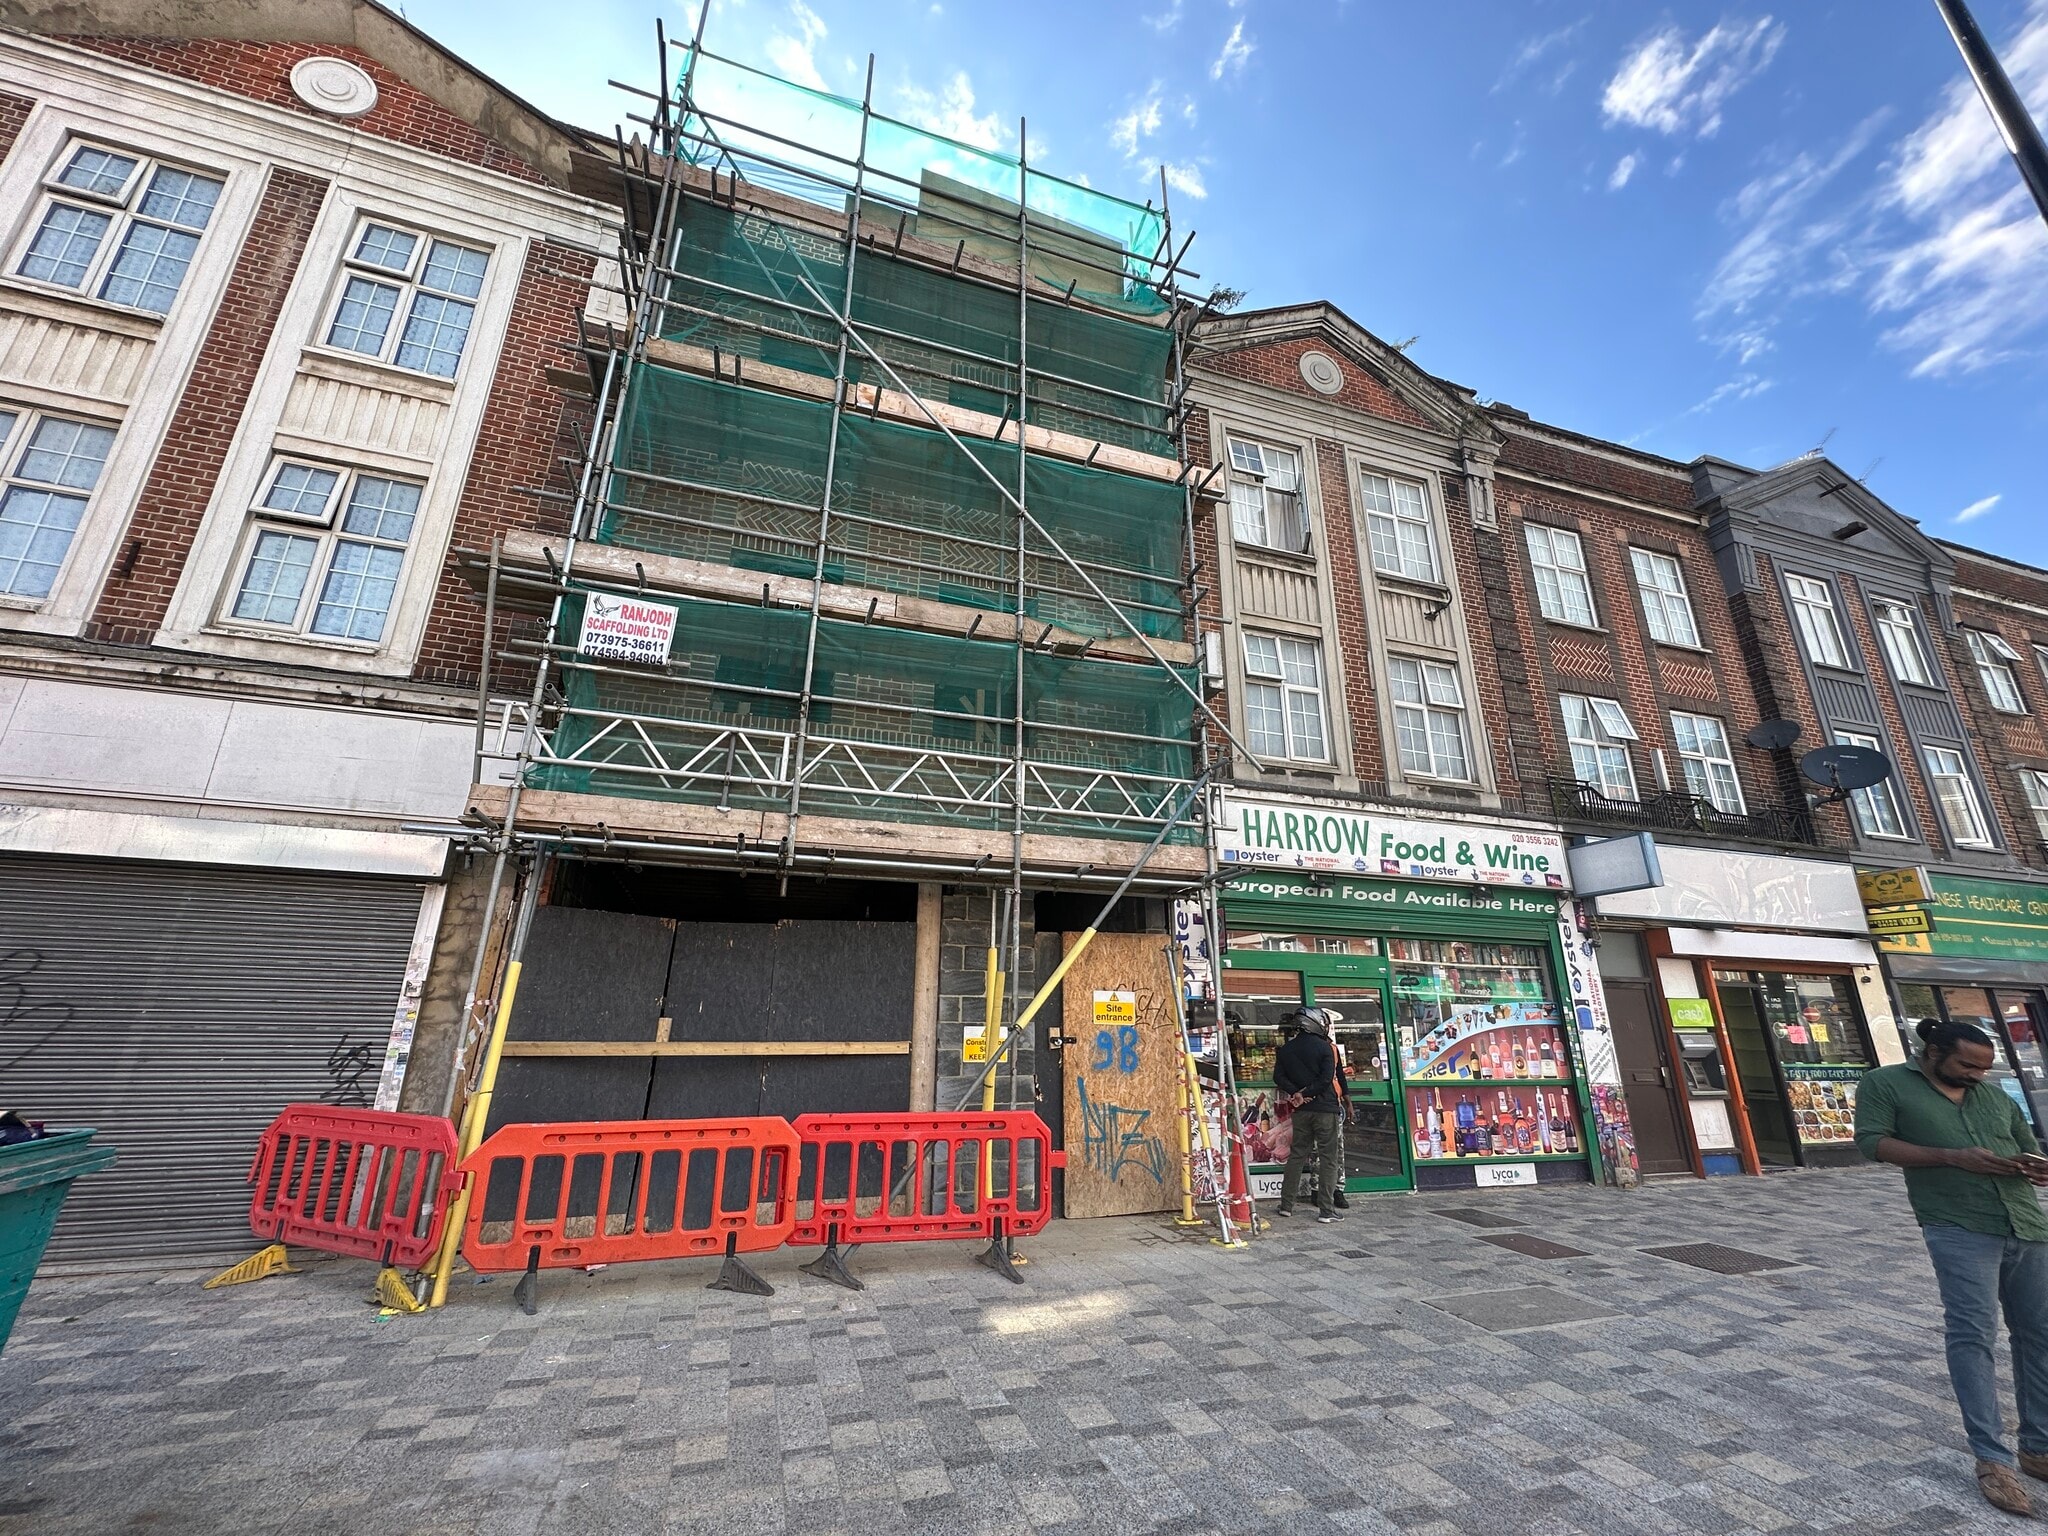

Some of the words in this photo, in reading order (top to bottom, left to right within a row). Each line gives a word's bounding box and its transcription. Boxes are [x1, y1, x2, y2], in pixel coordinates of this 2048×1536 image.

[620, 604, 672, 627] RANJODH
[586, 617, 650, 638] SCAFFOLDING
[652, 627, 668, 640] LTD
[586, 632, 664, 652] 073975-36611
[584, 644, 664, 666] 074594-94904
[1242, 808, 1370, 856] HARROW
[1380, 832, 1446, 864] Food
[1455, 840, 1476, 866] &
[1483, 843, 1550, 872] Wine
[1512, 834, 1524, 842] 020
[1526, 835, 1542, 845] 3556
[1544, 837, 1559, 846] 3242
[1240, 850, 1280, 863] oyster
[1425, 866, 1458, 877] oyster
[1342, 885, 1397, 903] Food
[1404, 890, 1503, 910] Available
[1510, 898, 1556, 914] Here
[1966, 895, 2025, 914] HEALTHCARE
[1561, 914, 1582, 994] oyster
[1586, 968, 1596, 1005] NATIONAL
[1096, 1012, 1133, 1022] entrance
[1106, 1004, 1122, 1013] Site
[1678, 1004, 1704, 1020] cash
[1491, 1169, 1514, 1181] Lyca
